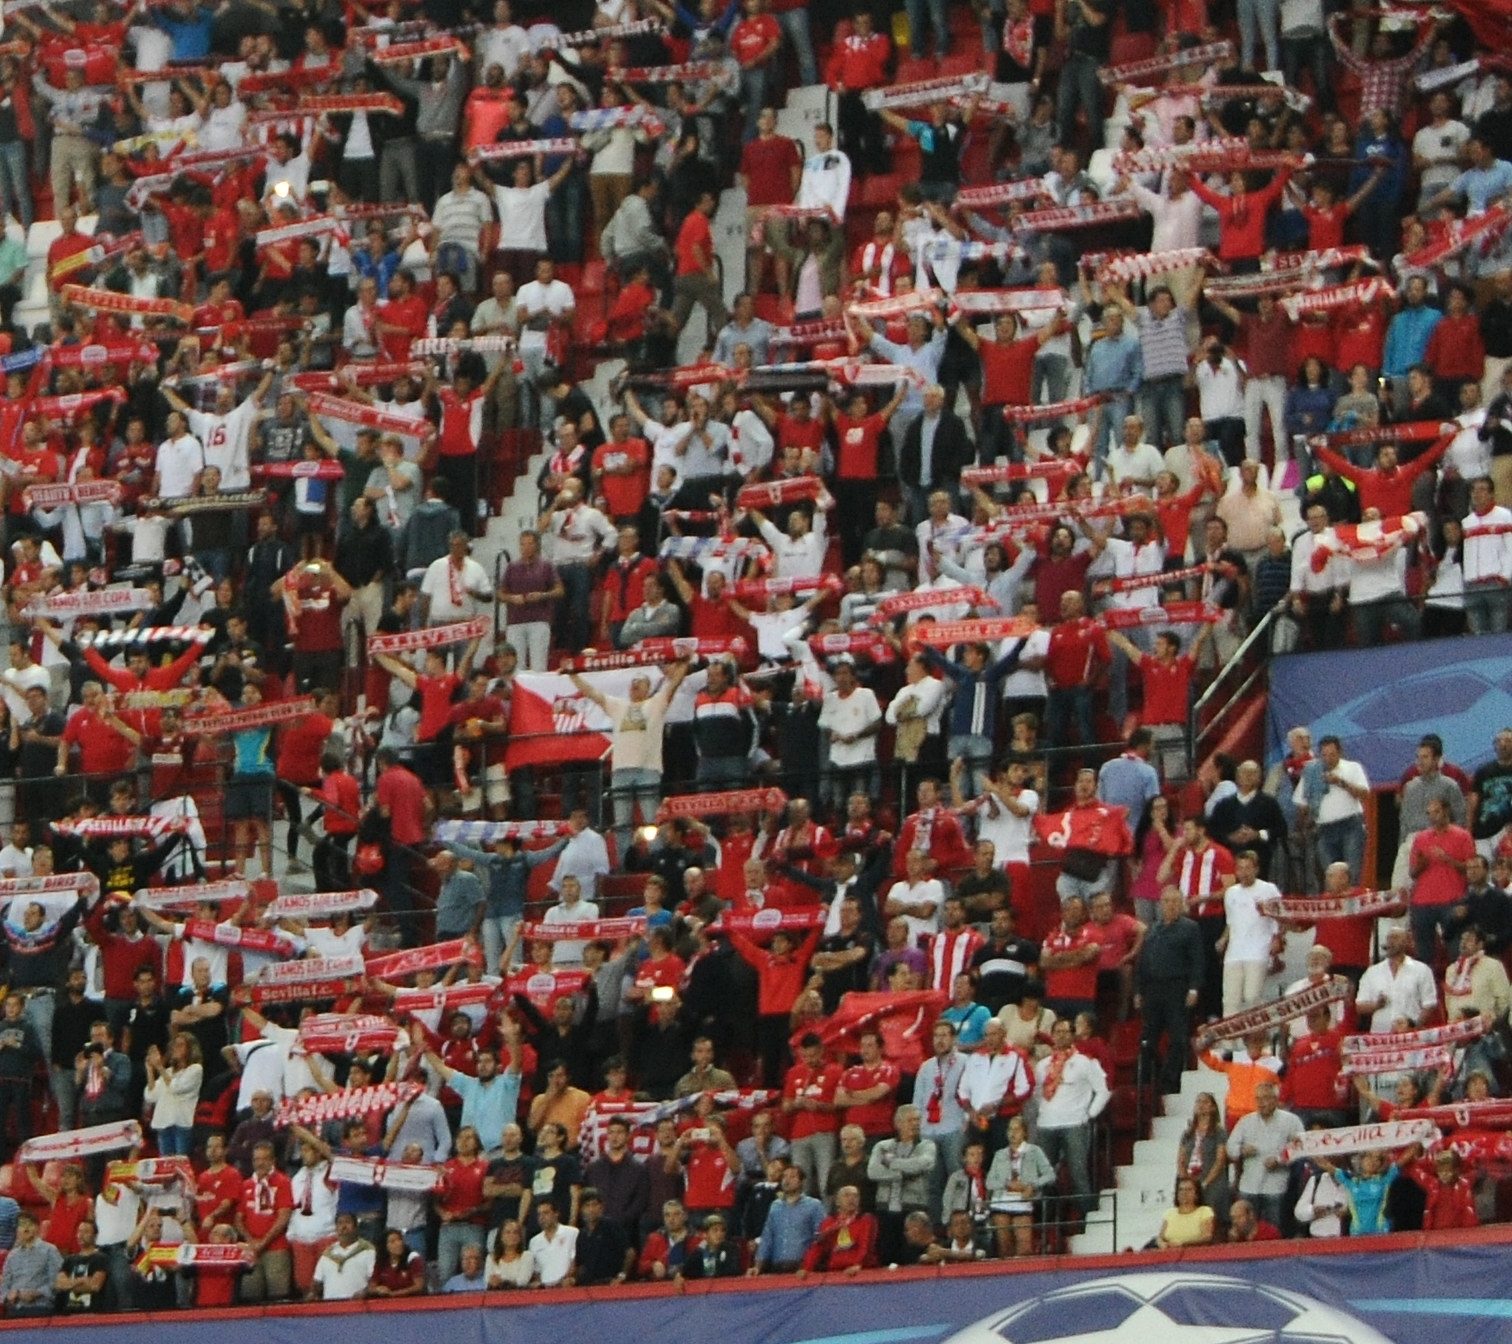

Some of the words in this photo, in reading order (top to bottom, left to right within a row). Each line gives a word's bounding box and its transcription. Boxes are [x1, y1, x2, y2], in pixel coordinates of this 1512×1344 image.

[43, 875, 77, 888] BIRIS
[1282, 898, 1342, 915] SEVILLA
[261, 985, 307, 1000] Sevilla
[1363, 1032, 1420, 1046] SEVILLA
[1350, 1054, 1404, 1066] SEVILLA
[1311, 1126, 1389, 1148] Sevilla
